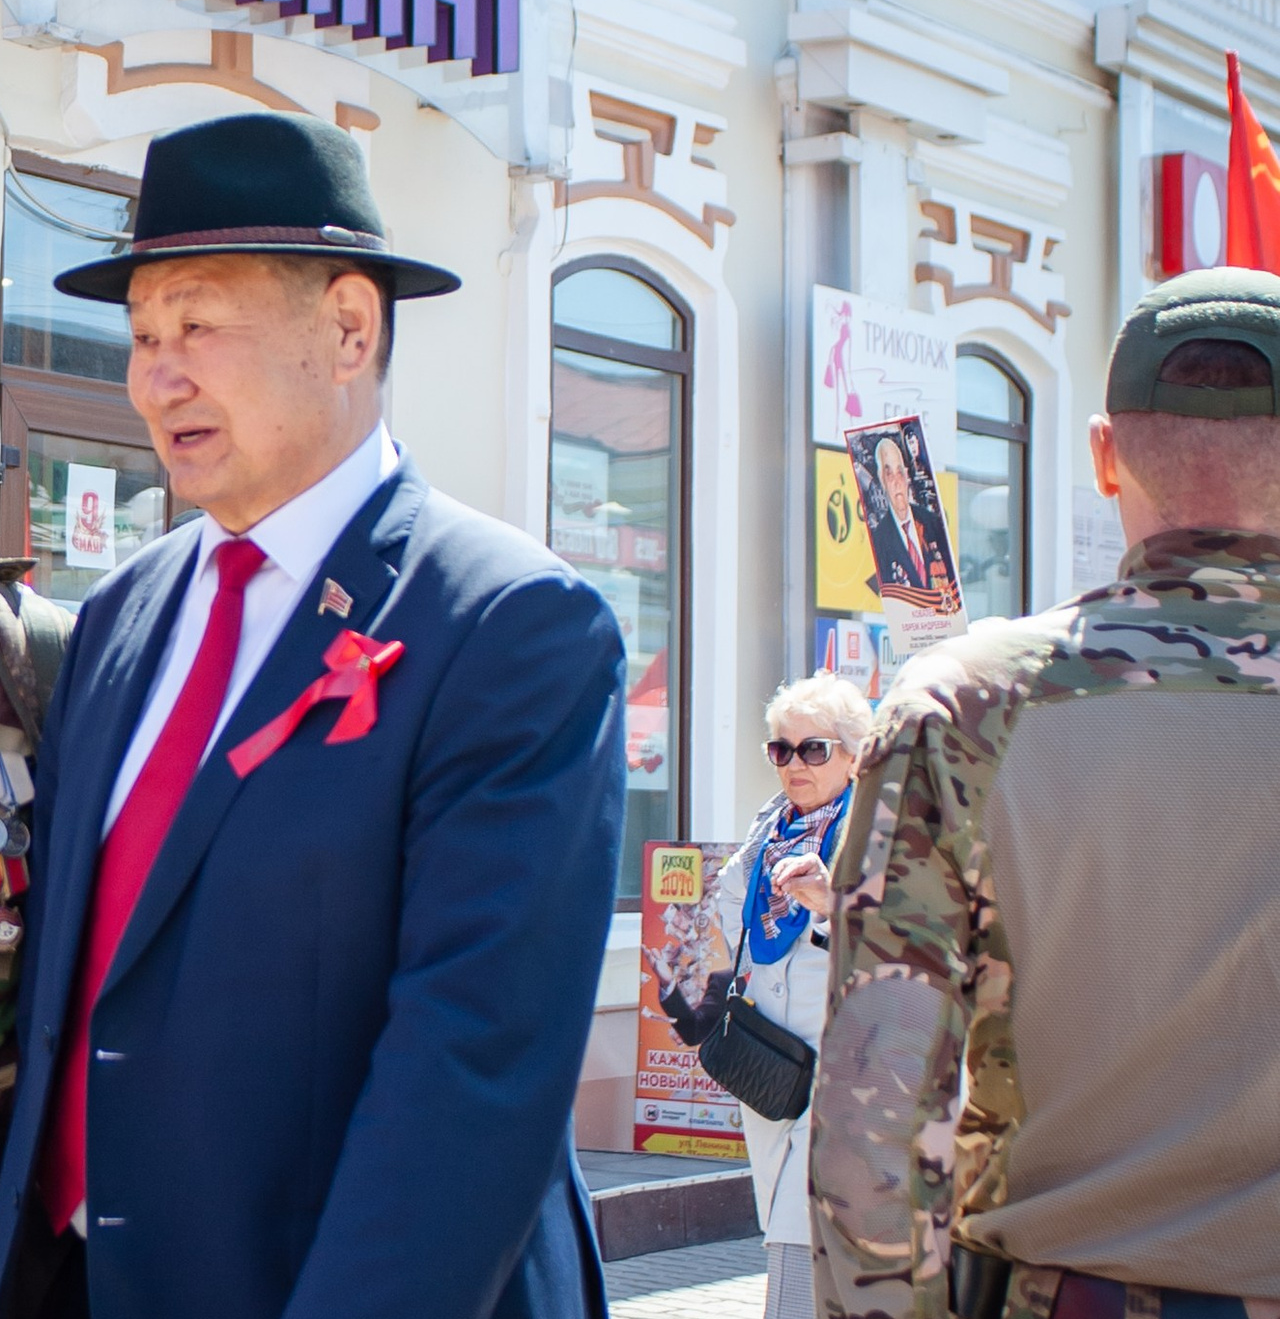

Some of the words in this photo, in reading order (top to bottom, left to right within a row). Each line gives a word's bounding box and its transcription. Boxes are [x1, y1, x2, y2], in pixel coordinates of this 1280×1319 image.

[863, 320, 949, 371] ТРИКОТАЖ
[81, 491, 99, 533] 9
[660, 870, 695, 897] ЛОТО
[639, 1072, 690, 1090] НОВЫЙ
